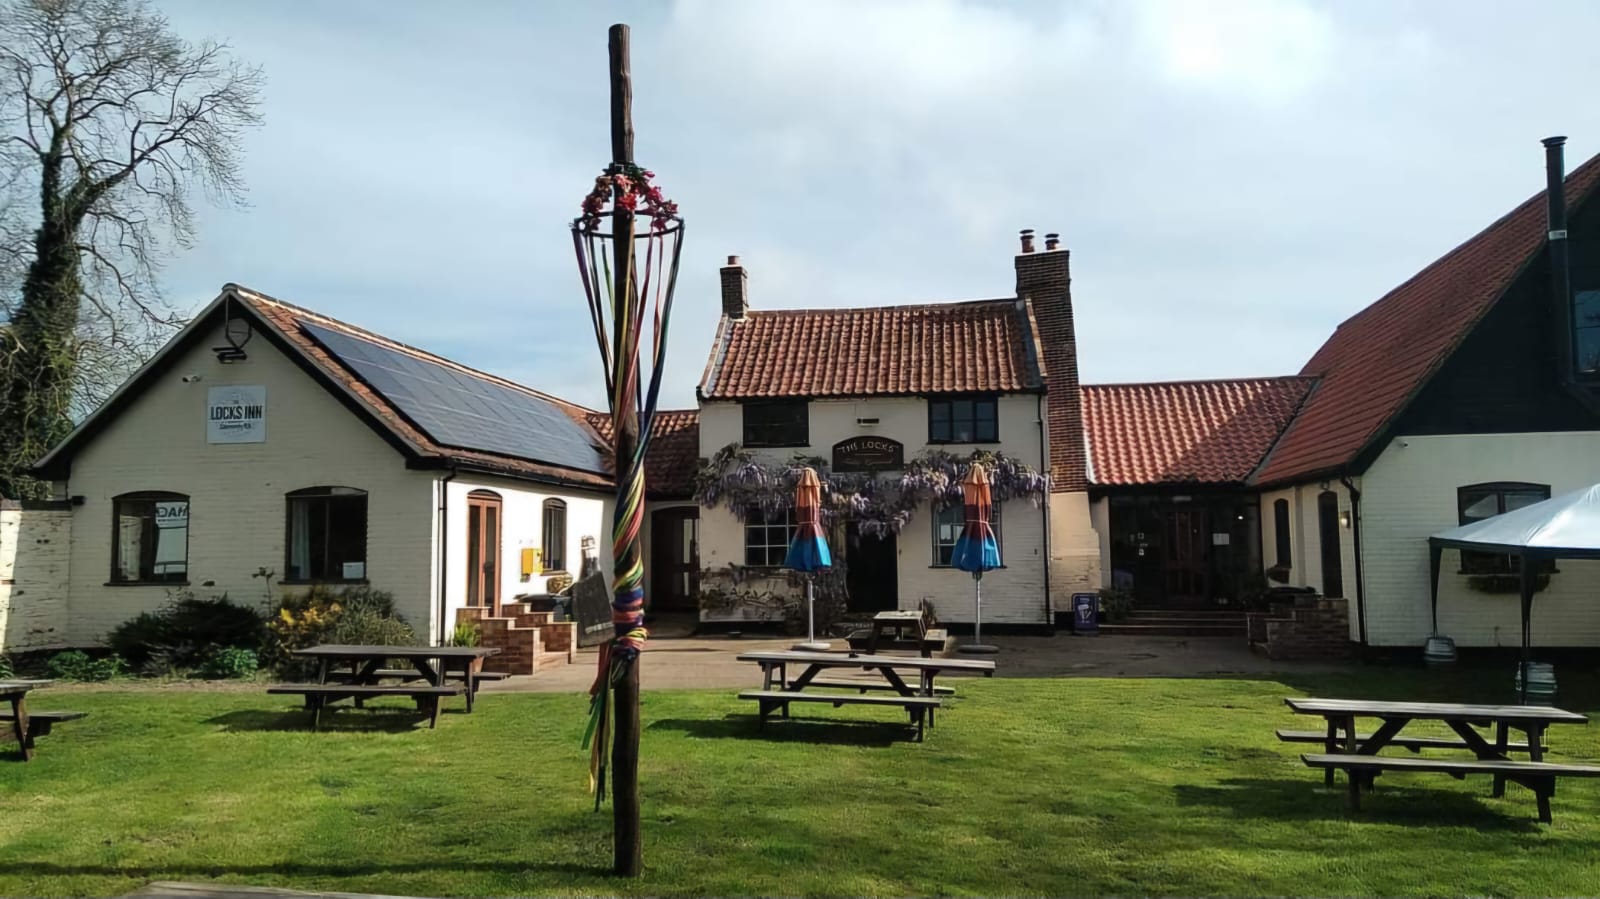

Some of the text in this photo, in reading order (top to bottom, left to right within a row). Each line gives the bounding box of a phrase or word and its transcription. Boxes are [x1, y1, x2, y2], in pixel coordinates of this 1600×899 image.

[210, 404, 263, 420] LOCKS INN
[862, 441, 898, 453] LOCKS
